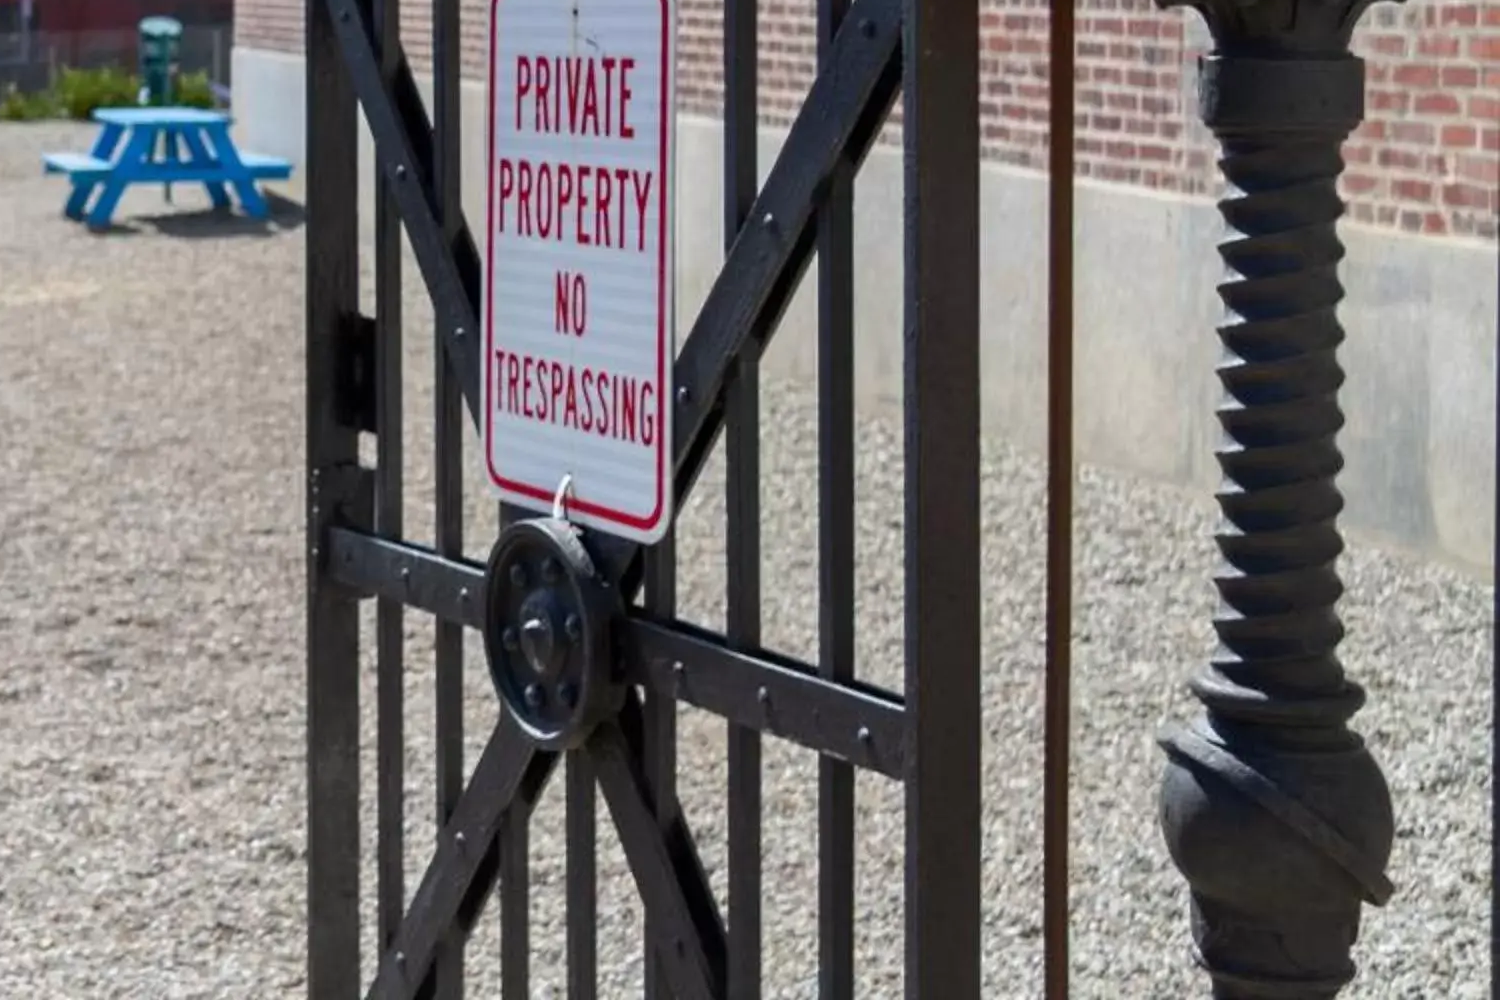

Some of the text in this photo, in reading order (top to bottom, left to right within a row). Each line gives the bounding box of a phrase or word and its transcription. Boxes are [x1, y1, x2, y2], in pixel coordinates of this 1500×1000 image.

[515, 55, 636, 140] PRIVATE
[499, 158, 653, 252] PROPERTY
[556, 271, 587, 338] NO
[495, 350, 654, 448] TRESPASSING
